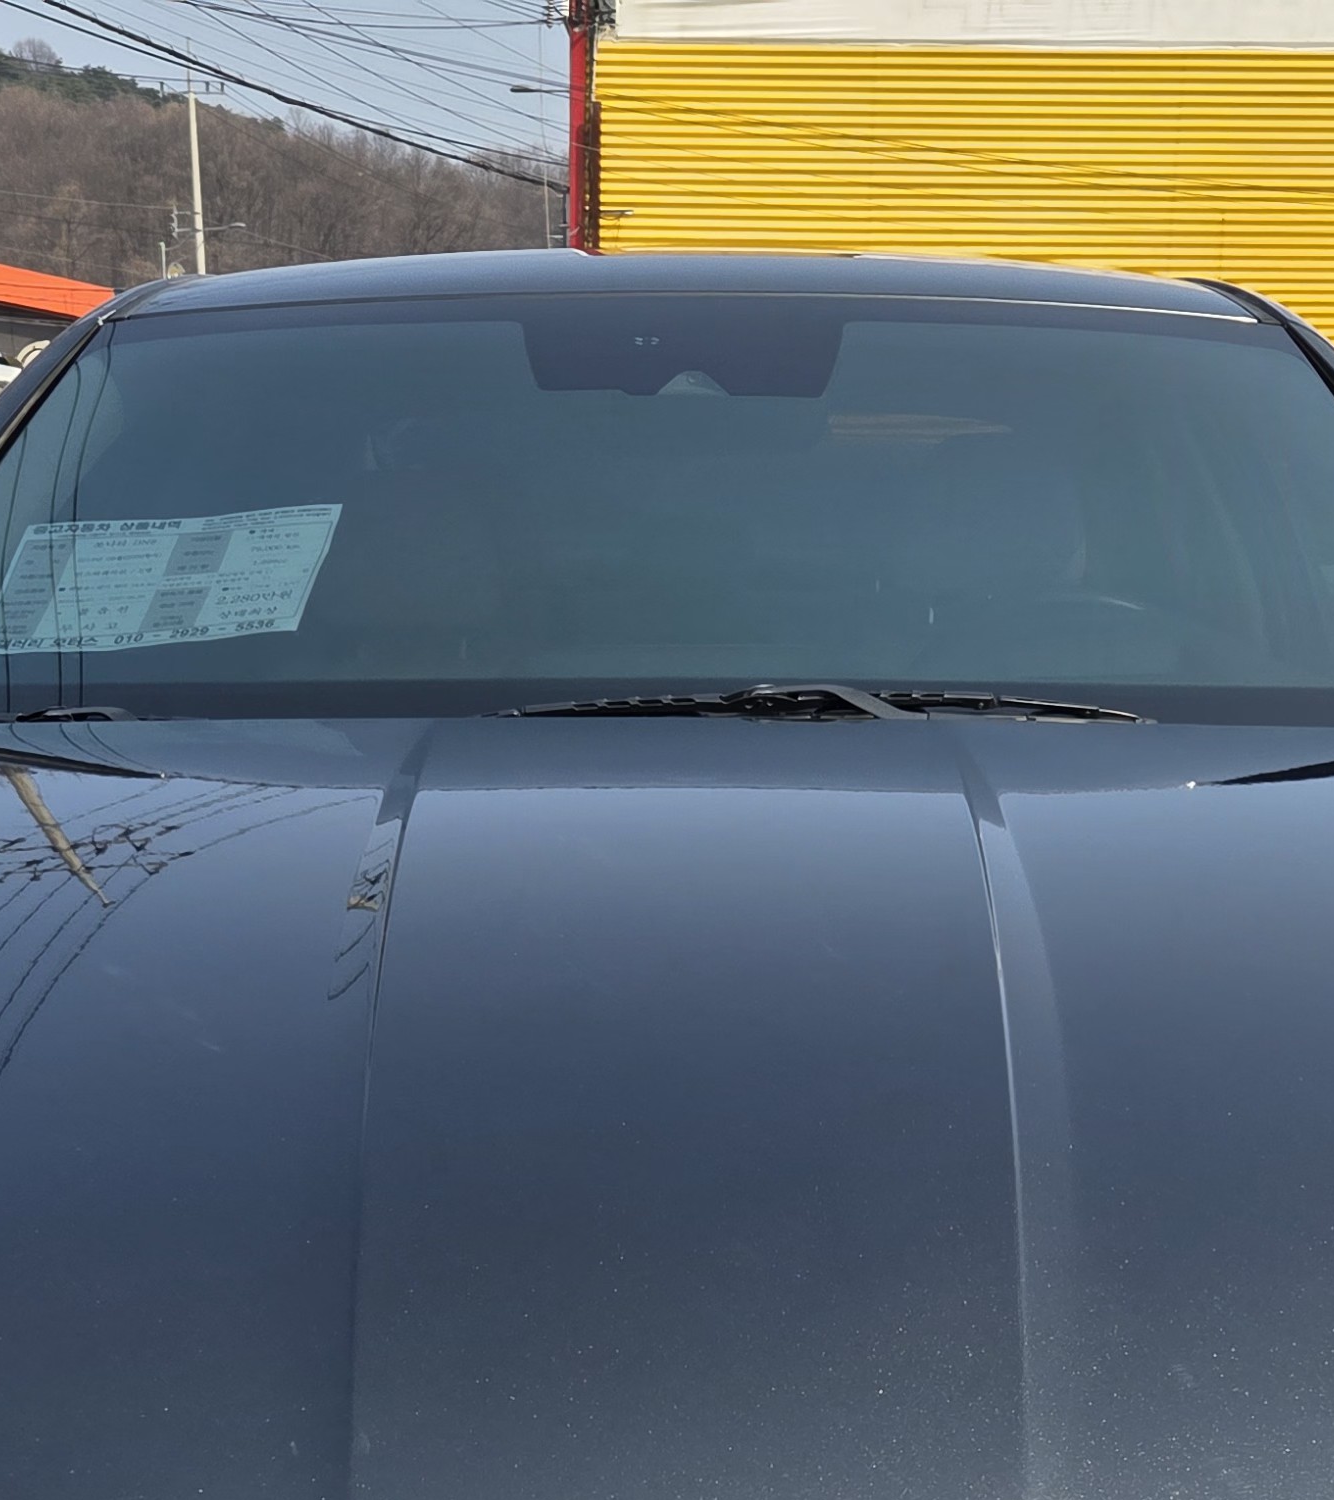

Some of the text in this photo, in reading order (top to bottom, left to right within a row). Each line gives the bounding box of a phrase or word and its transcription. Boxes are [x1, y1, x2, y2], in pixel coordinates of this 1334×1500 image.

[114, 633, 144, 645] 010
[171, 626, 209, 638] 2929
[235, 619, 275, 631] 5536
